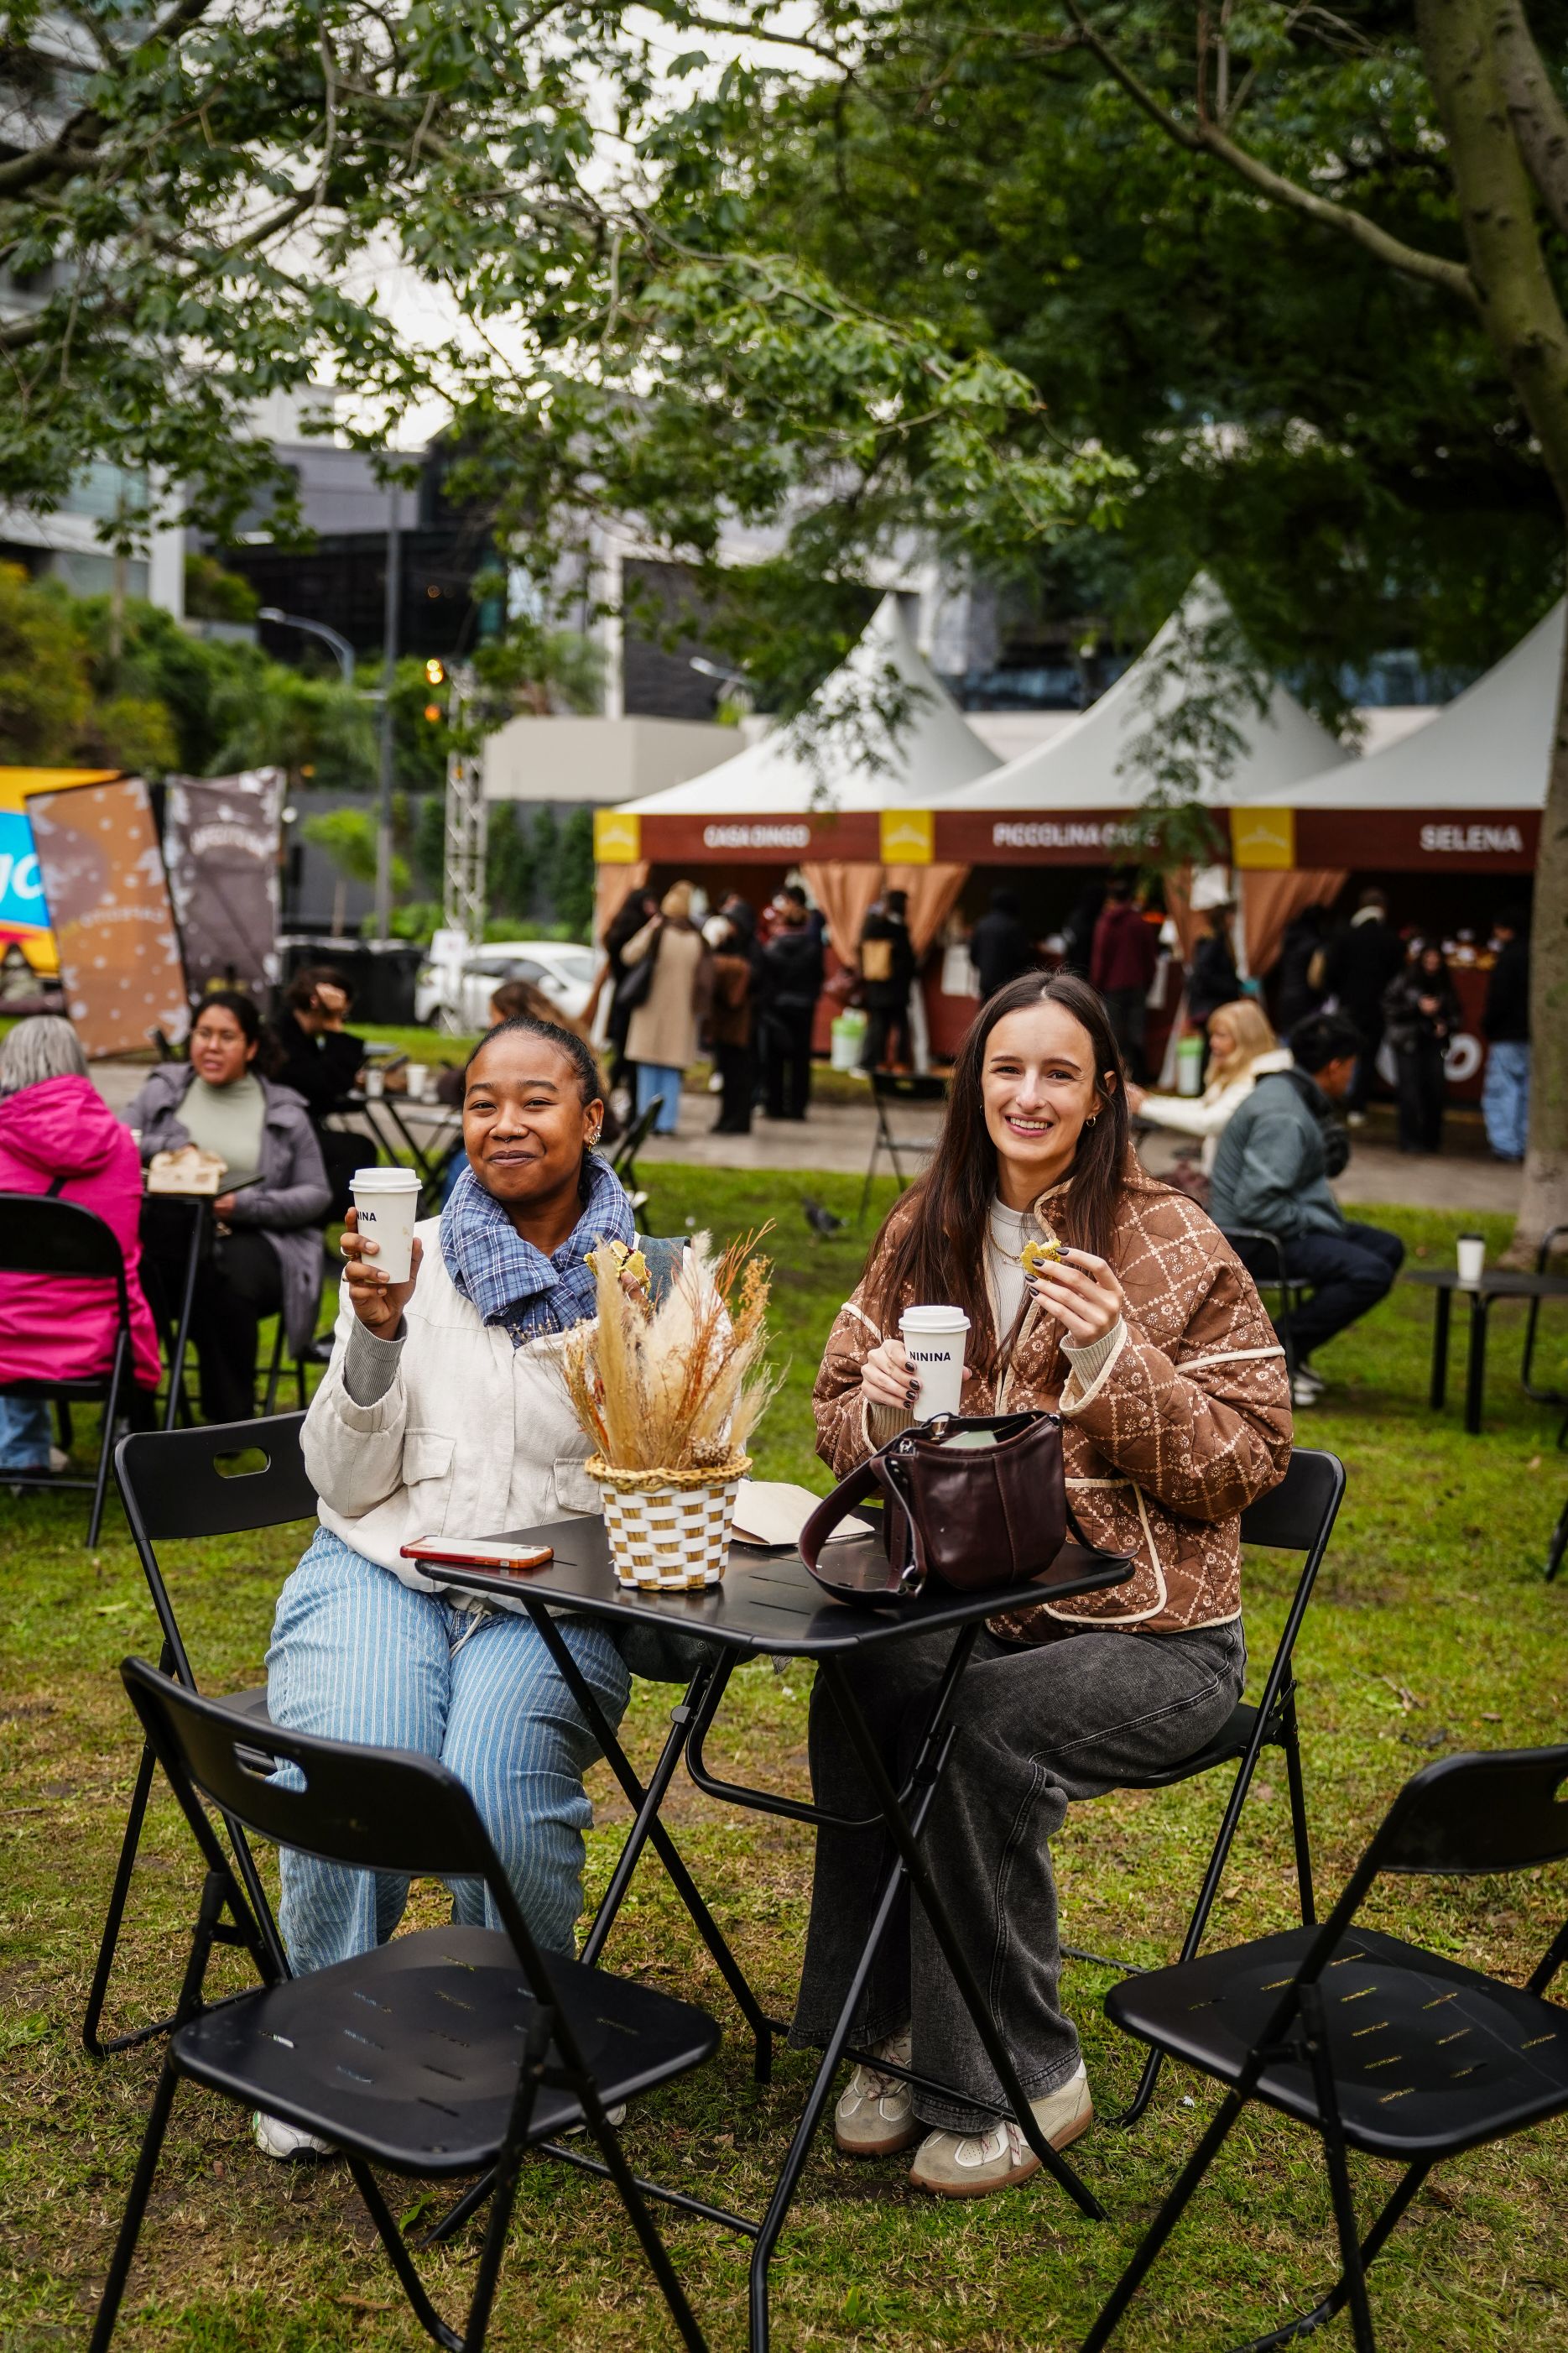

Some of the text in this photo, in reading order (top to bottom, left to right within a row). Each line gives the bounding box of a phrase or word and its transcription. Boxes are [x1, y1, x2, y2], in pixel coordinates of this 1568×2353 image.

[993, 822, 1100, 847] PICCOLINA
[1420, 824, 1524, 853] SELENA
[909, 1351, 951, 1362] NININA
